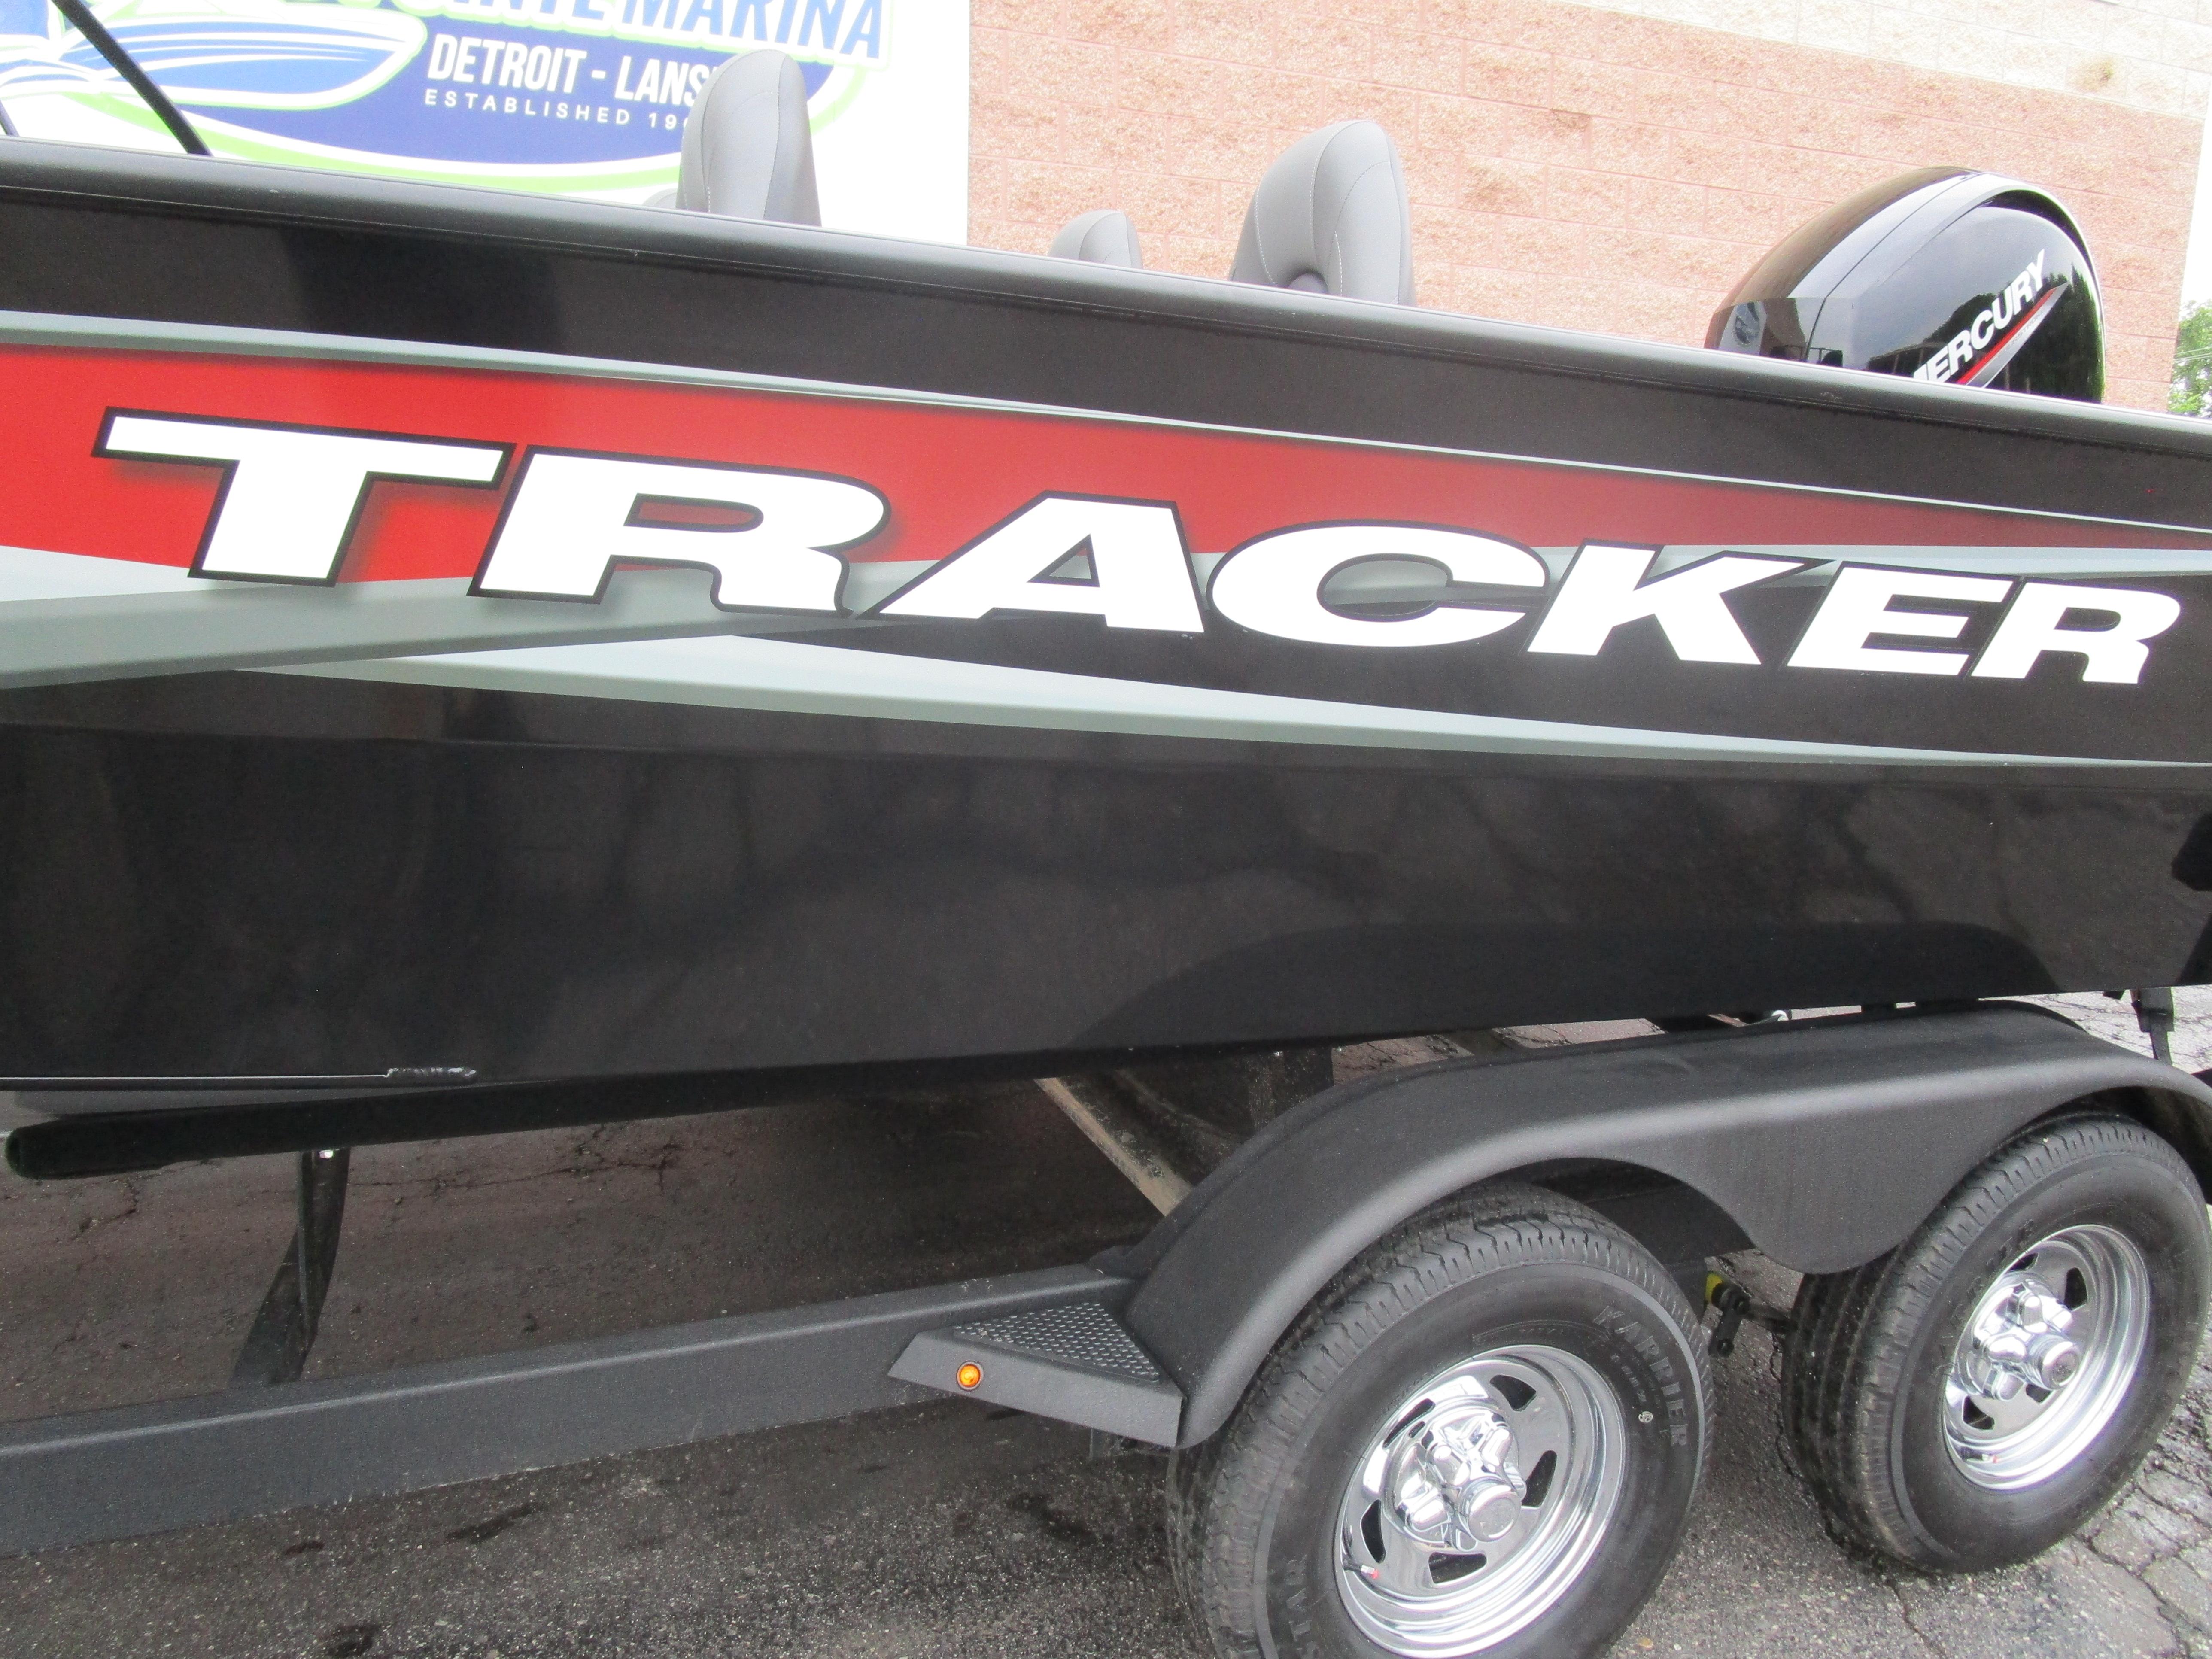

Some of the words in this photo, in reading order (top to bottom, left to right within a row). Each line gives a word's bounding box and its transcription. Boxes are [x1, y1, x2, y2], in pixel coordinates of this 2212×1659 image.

[424, 88, 631, 125] ESTABLISHED
[648, 112, 689, 130] 19
[428, 33, 587, 94] DETROIT
[614, 55, 716, 107] LANS
[92, 406, 2184, 687] TRACKER
[1592, 1305, 1689, 1447] KARRIER
